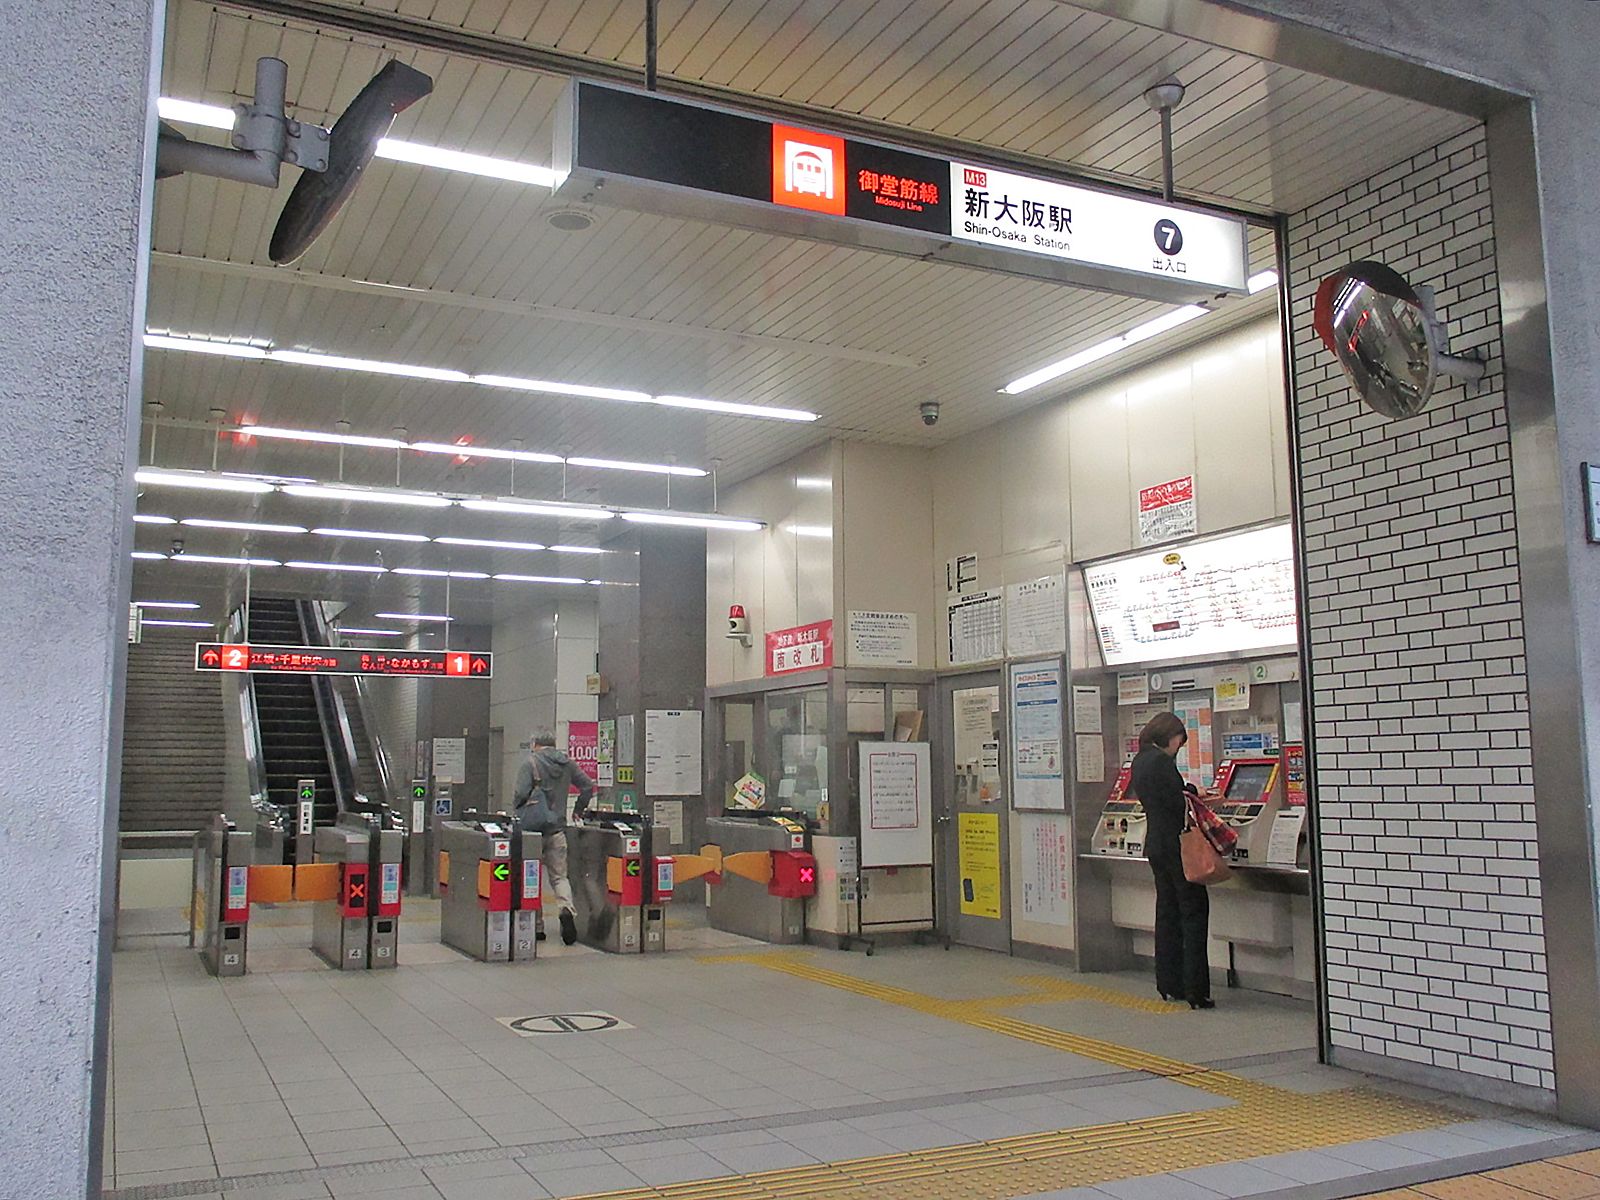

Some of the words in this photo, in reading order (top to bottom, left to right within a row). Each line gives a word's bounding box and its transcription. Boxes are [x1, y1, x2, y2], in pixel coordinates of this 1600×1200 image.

[964, 170, 986, 186] M13
[858, 169, 939, 205] 御堂筋線
[875, 196, 905, 210] Midosuji
[906, 201, 923, 212] Line
[964, 188, 1073, 235] 新大阪駅
[964, 221, 1027, 243] Shin-Osaka
[1033, 234, 1071, 251] Station
[1161, 226, 1176, 250] 7
[1152, 257, 1187, 273] 出入口
[228, 649, 242, 667] 2
[454, 656, 463, 673] 1
[1256, 665, 1264, 678] 2
[495, 943, 502, 951] 3
[521, 941, 529, 949] 2
[626, 935, 633, 943] 2
[227, 955, 236, 964] 4
